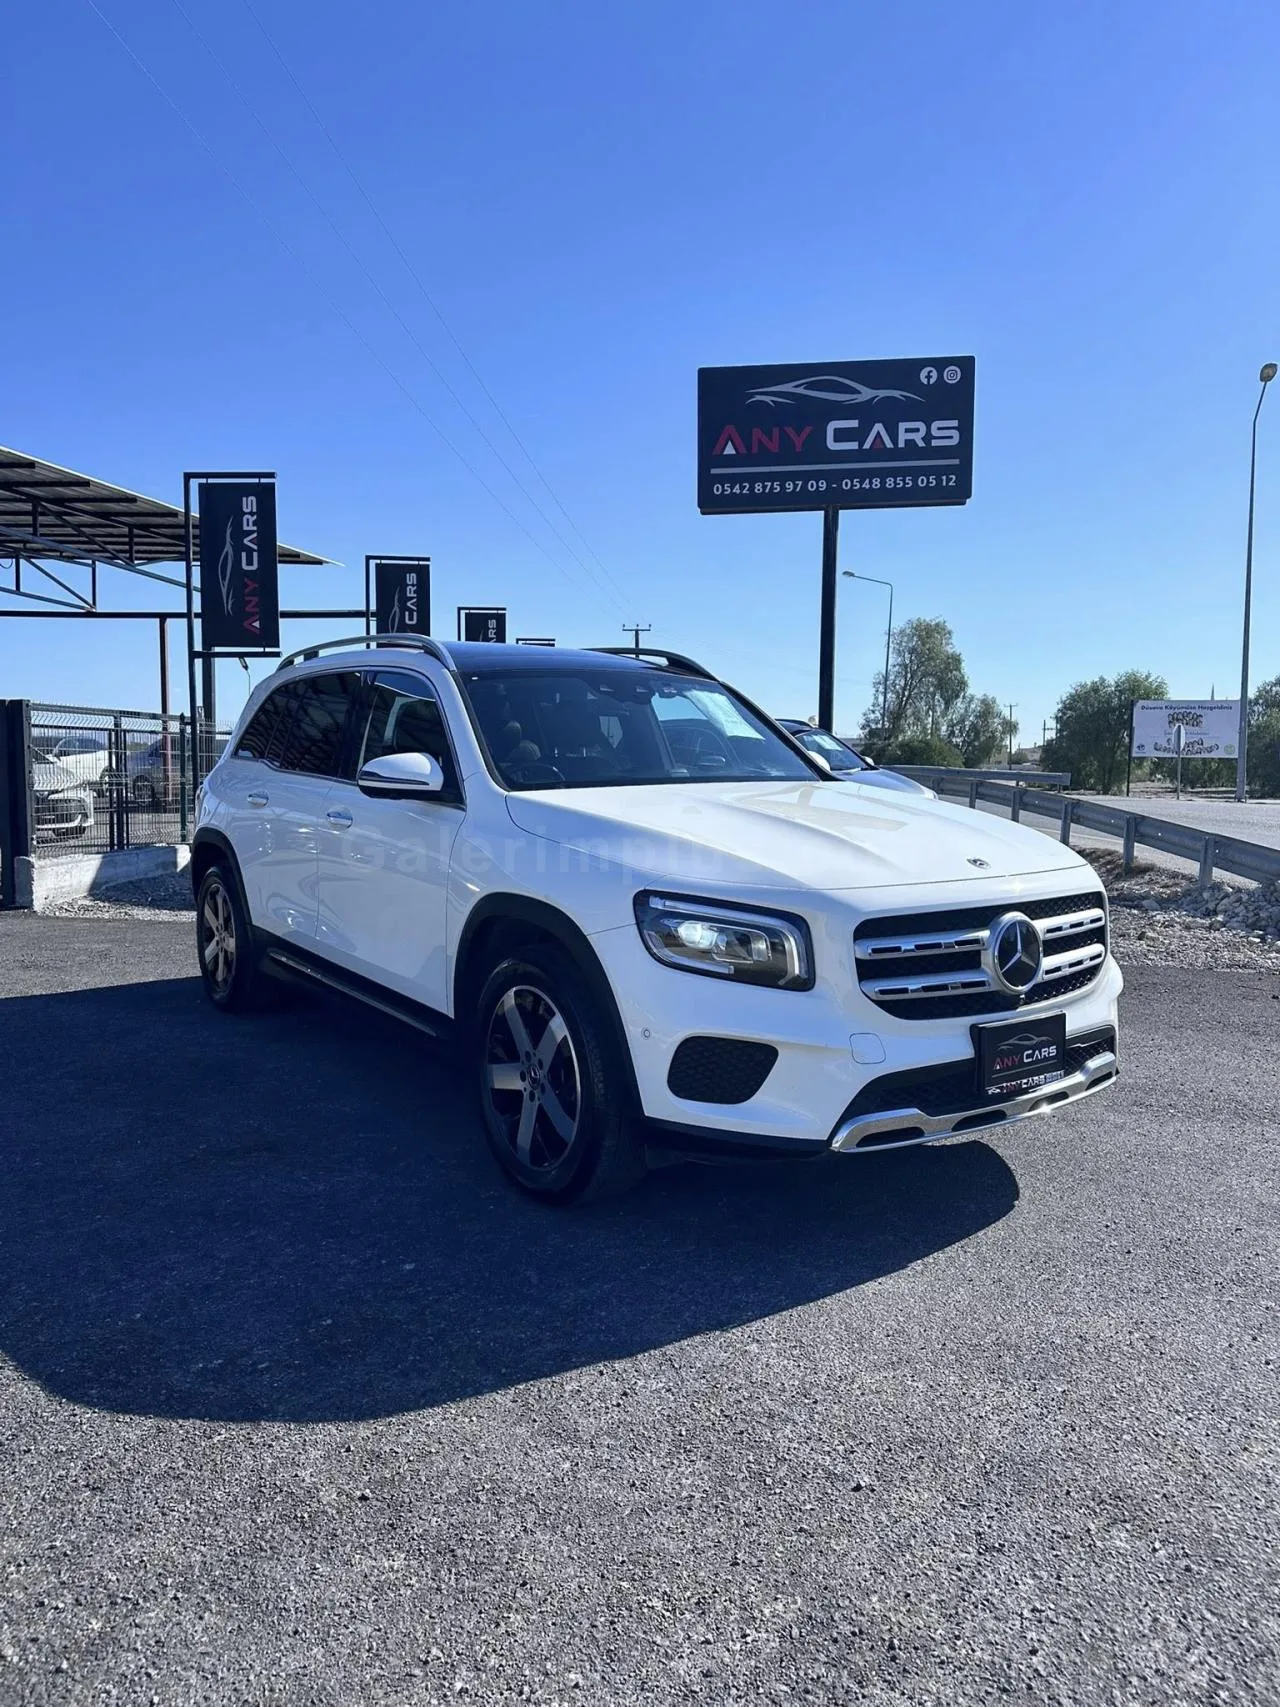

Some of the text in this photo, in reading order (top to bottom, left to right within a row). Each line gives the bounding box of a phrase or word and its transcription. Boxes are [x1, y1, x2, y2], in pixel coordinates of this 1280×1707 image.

[712, 419, 961, 455] ANY CARS
[713, 482, 751, 495] 0542
[754, 481, 781, 494] 875
[785, 480, 802, 493] 97
[807, 479, 827, 492] 09
[842, 477, 881, 490] 0548
[885, 476, 913, 489] 855
[917, 475, 937, 488] 05
[941, 474, 957, 487] 12
[241, 495, 261, 635] ANY CARS
[405, 572, 417, 625] CARS
[993, 1045, 1057, 1070] ANY CARS
